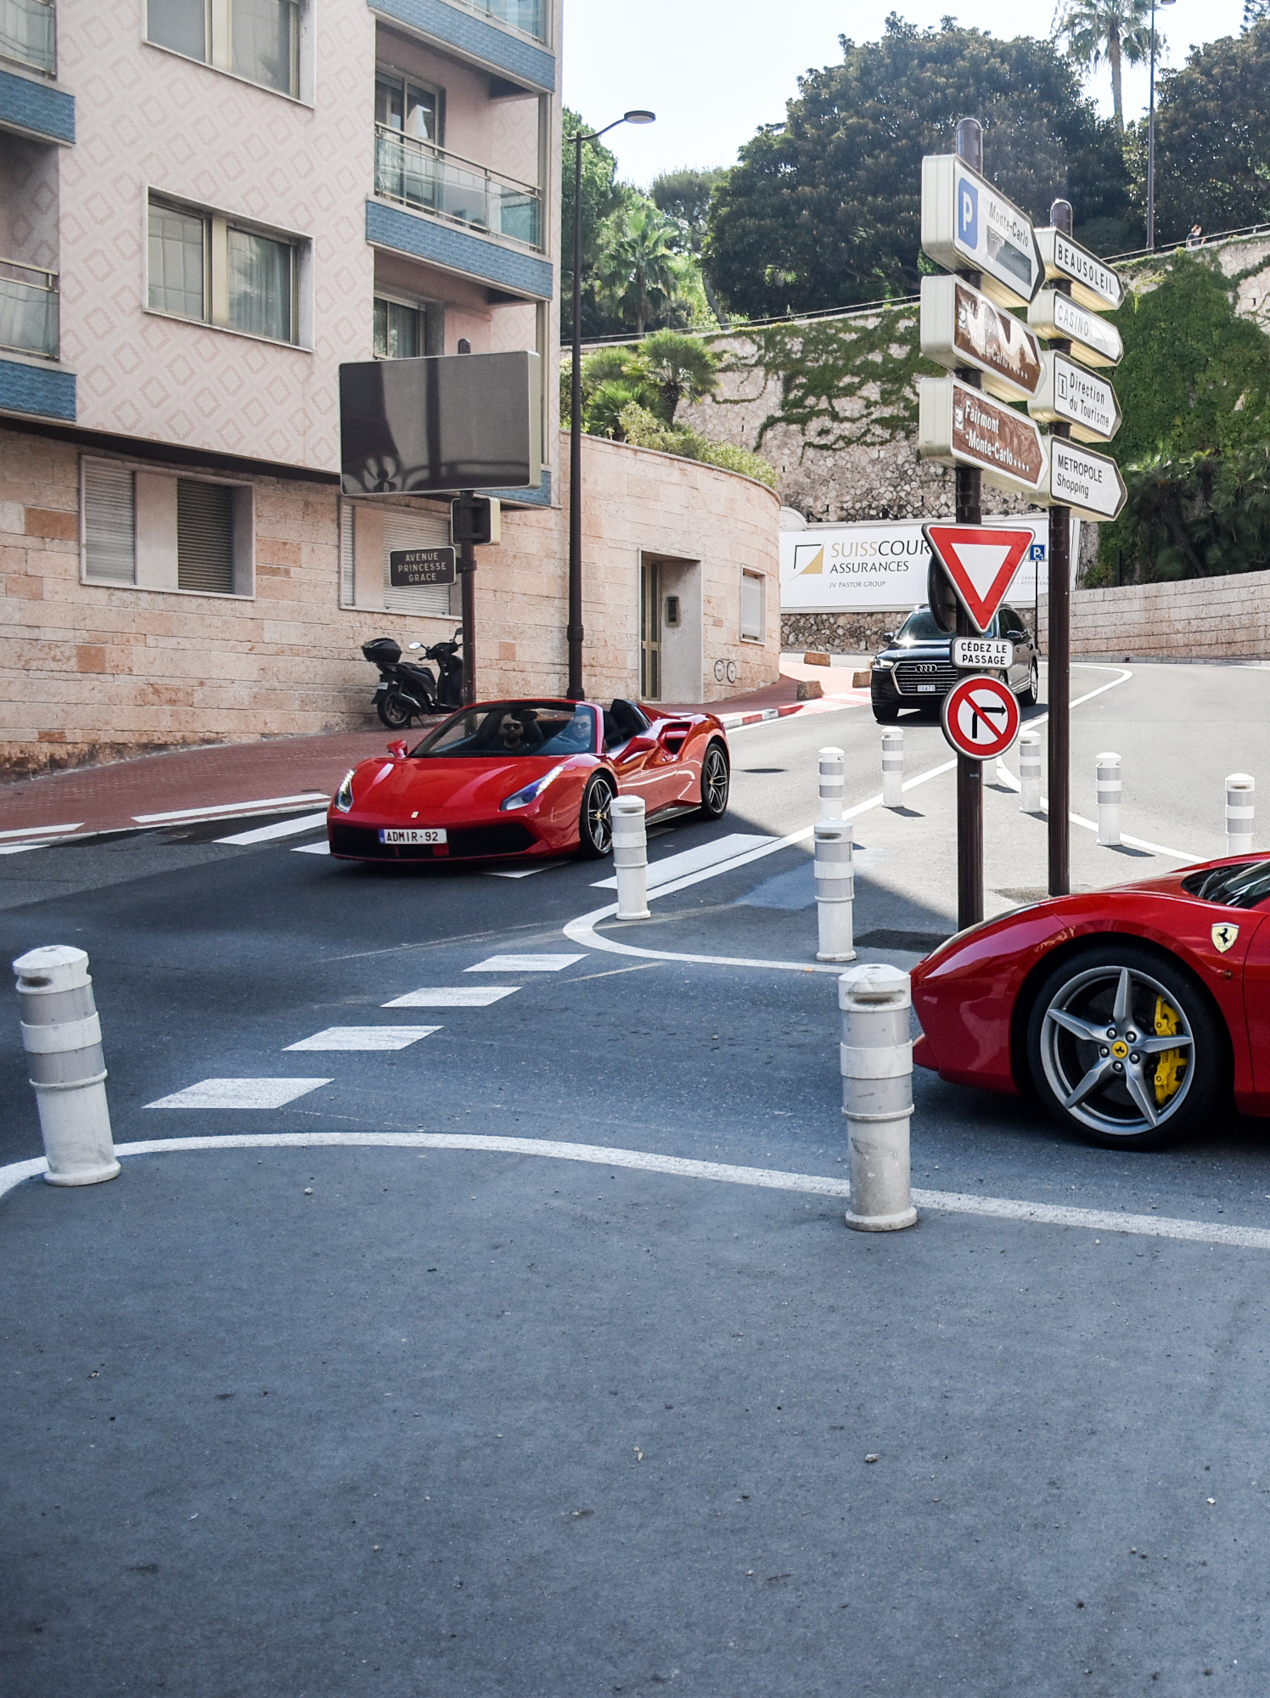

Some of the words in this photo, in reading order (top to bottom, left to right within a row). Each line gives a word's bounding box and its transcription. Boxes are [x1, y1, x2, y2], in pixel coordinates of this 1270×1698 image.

[963, 191, 973, 231] P
[989, 202, 1029, 248] Monte-Carlo
[1058, 244, 1114, 295] BEAUSOLEIL
[1057, 305, 1089, 337] CASINO
[1069, 373, 1105, 404] Direction
[965, 401, 999, 434] Fairmont
[1069, 396, 1078, 411] du
[1080, 402, 1110, 428] Tourisme
[1057, 454, 1103, 483] METROPOLE
[1056, 474, 1089, 499] Shopping
[398, 562, 447, 572] PRINCESSE
[405, 552, 439, 561] AVENUE
[830, 561, 909, 574] ASSURANCES
[408, 573, 437, 582] GRACE
[829, 581, 836, 589] JV
[961, 641, 992, 652] CÉDEZ
[996, 644, 1007, 653] LE
[962, 654, 1006, 665] PASSAGE
[387, 831, 439, 842] ADMIR-92
